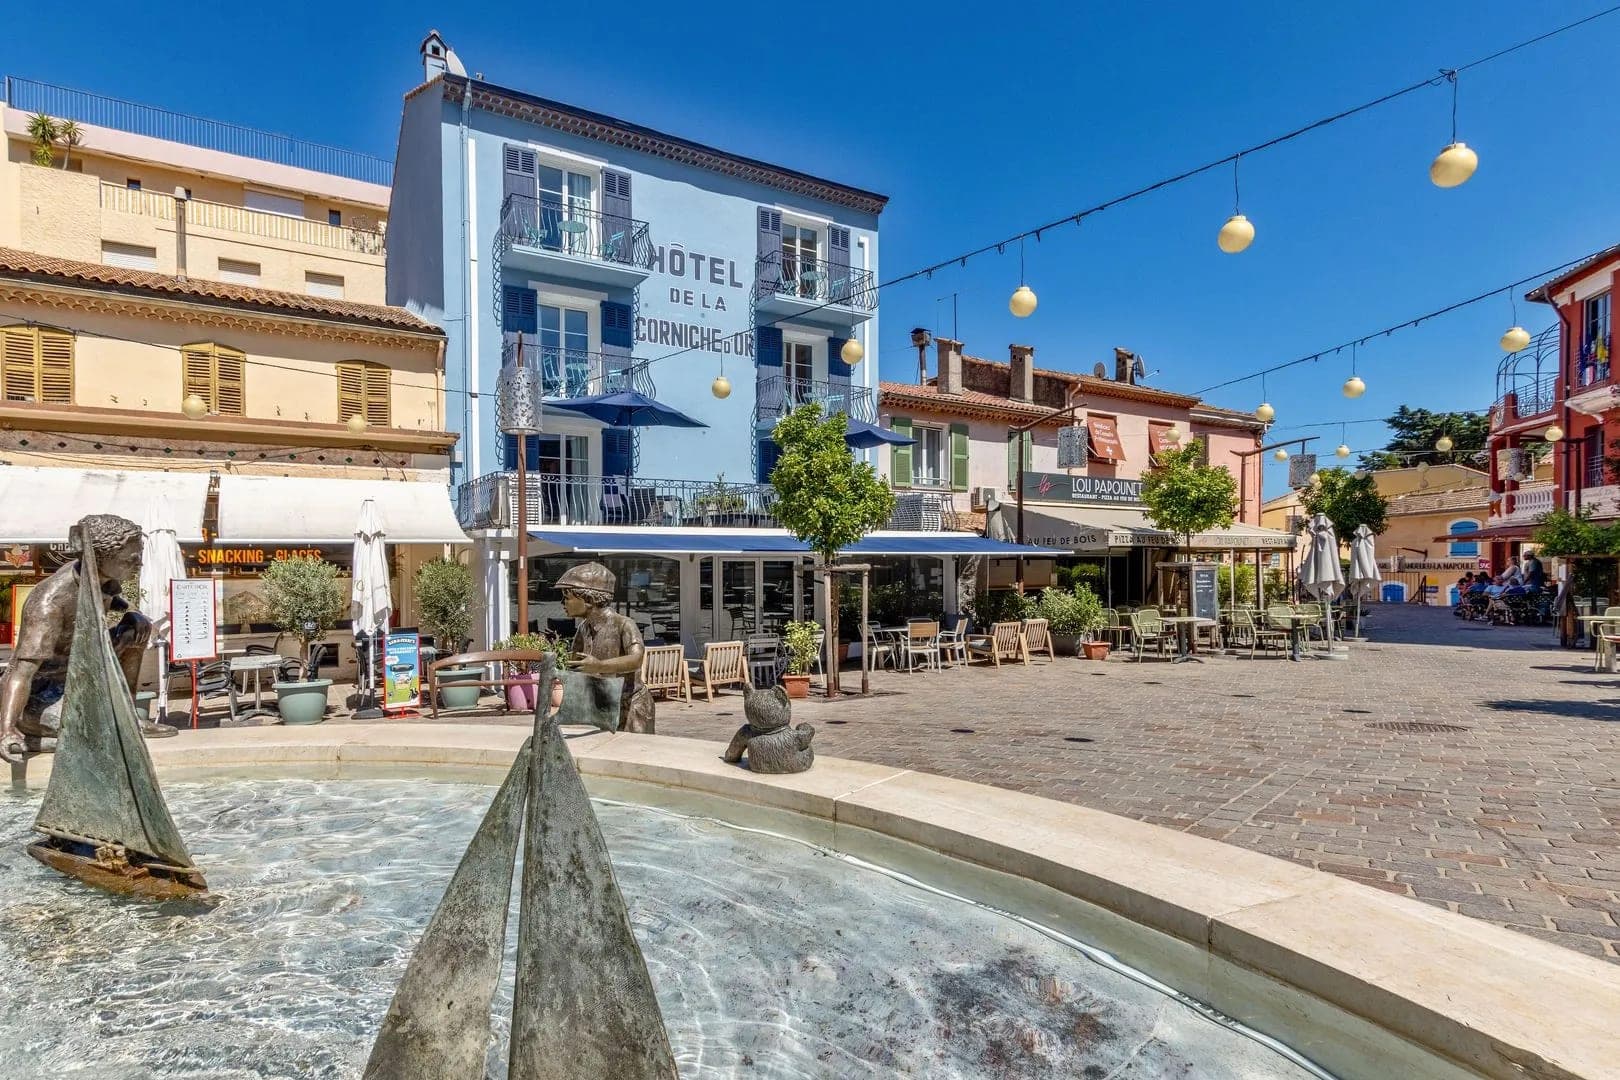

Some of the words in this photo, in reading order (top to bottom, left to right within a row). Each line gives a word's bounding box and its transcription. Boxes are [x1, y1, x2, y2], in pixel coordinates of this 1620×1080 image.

[669, 287, 694, 306] DE
[701, 293, 727, 312] LA
[636, 316, 722, 353] CORNICHE
[1072, 477, 1092, 493] LOU
[1094, 479, 1144, 497] PAPOUNET
[1060, 537, 1071, 545] DE
[1073, 534, 1097, 545] BOIS
[198, 549, 264, 564] SNACKING
[1443, 562, 1474, 570] NAPOULE
